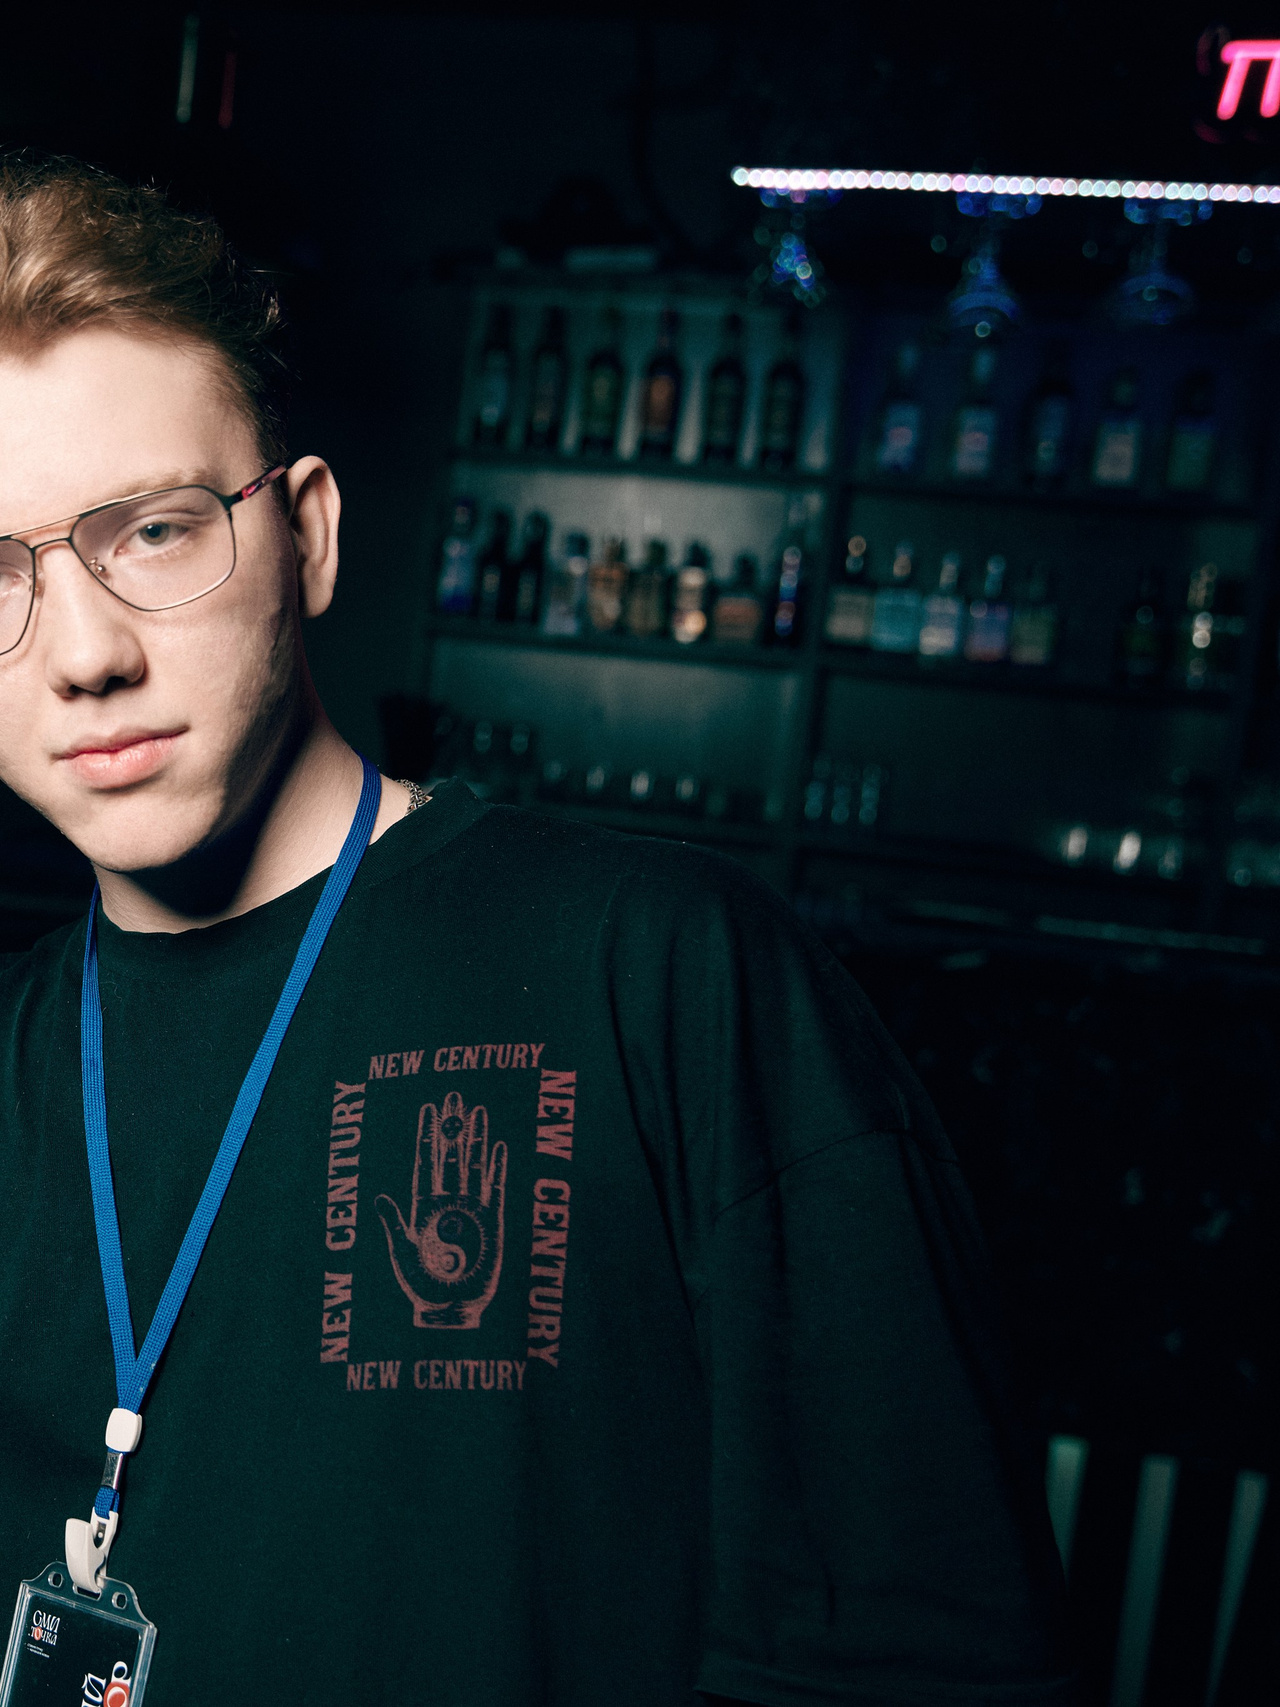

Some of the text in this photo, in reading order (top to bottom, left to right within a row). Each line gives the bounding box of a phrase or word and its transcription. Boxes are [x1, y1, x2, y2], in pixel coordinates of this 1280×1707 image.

[368, 1043, 545, 1080] NEW CENTURY
[320, 1080, 367, 1364] NEW CENTURY
[526, 1067, 578, 1368] NEW CENTURY
[346, 1359, 527, 1391] NEW CENTURY
